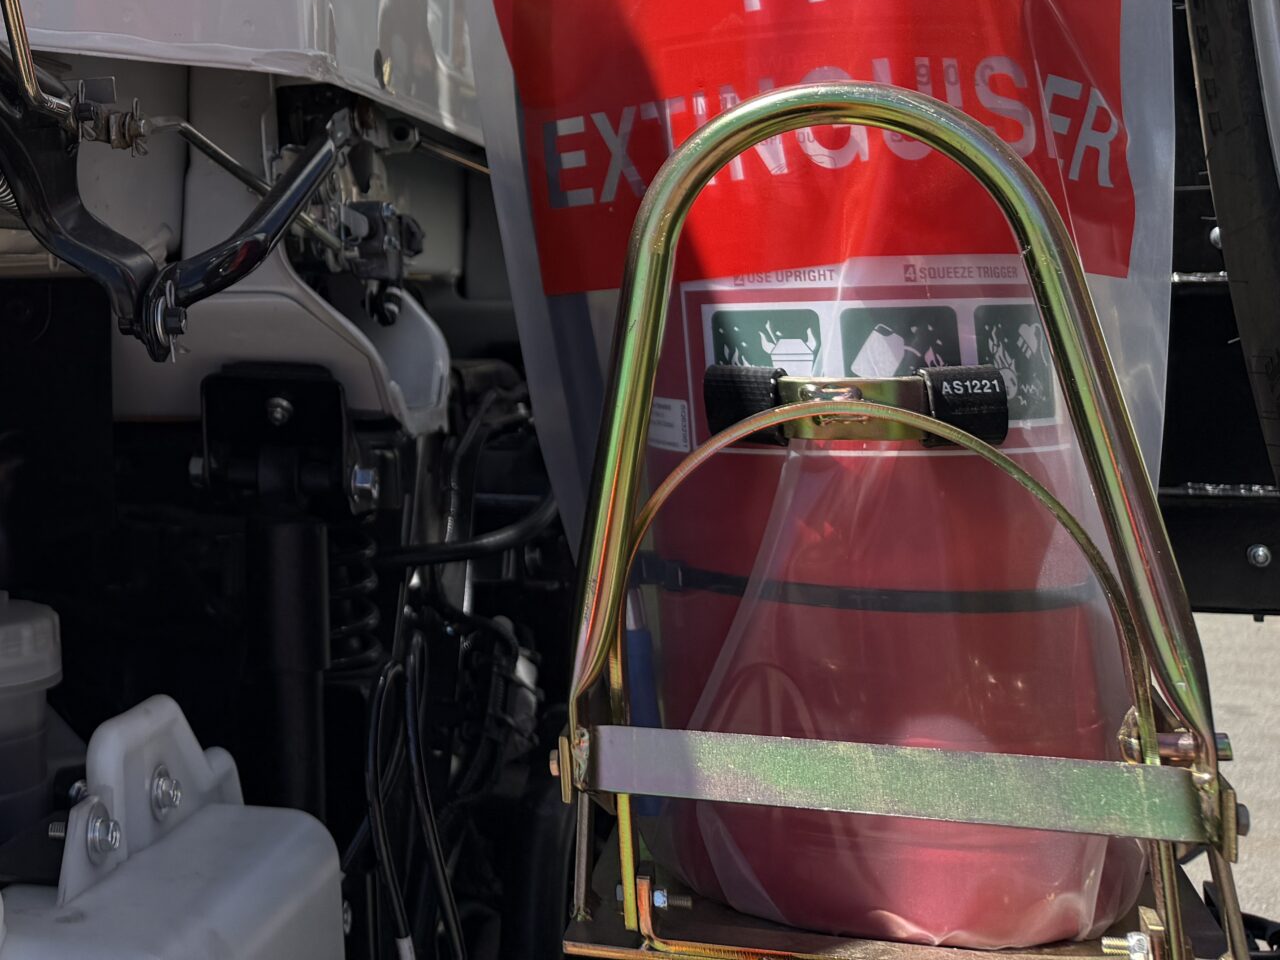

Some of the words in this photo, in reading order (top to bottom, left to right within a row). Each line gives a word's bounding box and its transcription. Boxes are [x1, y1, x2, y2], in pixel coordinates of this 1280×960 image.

[747, 271, 771, 284] USE
[775, 268, 835, 284] UPRIGHT
[920, 266, 974, 281] SQUEEZE
[977, 264, 1019, 279] TRIGGER
[941, 379, 1001, 395] AS1221
